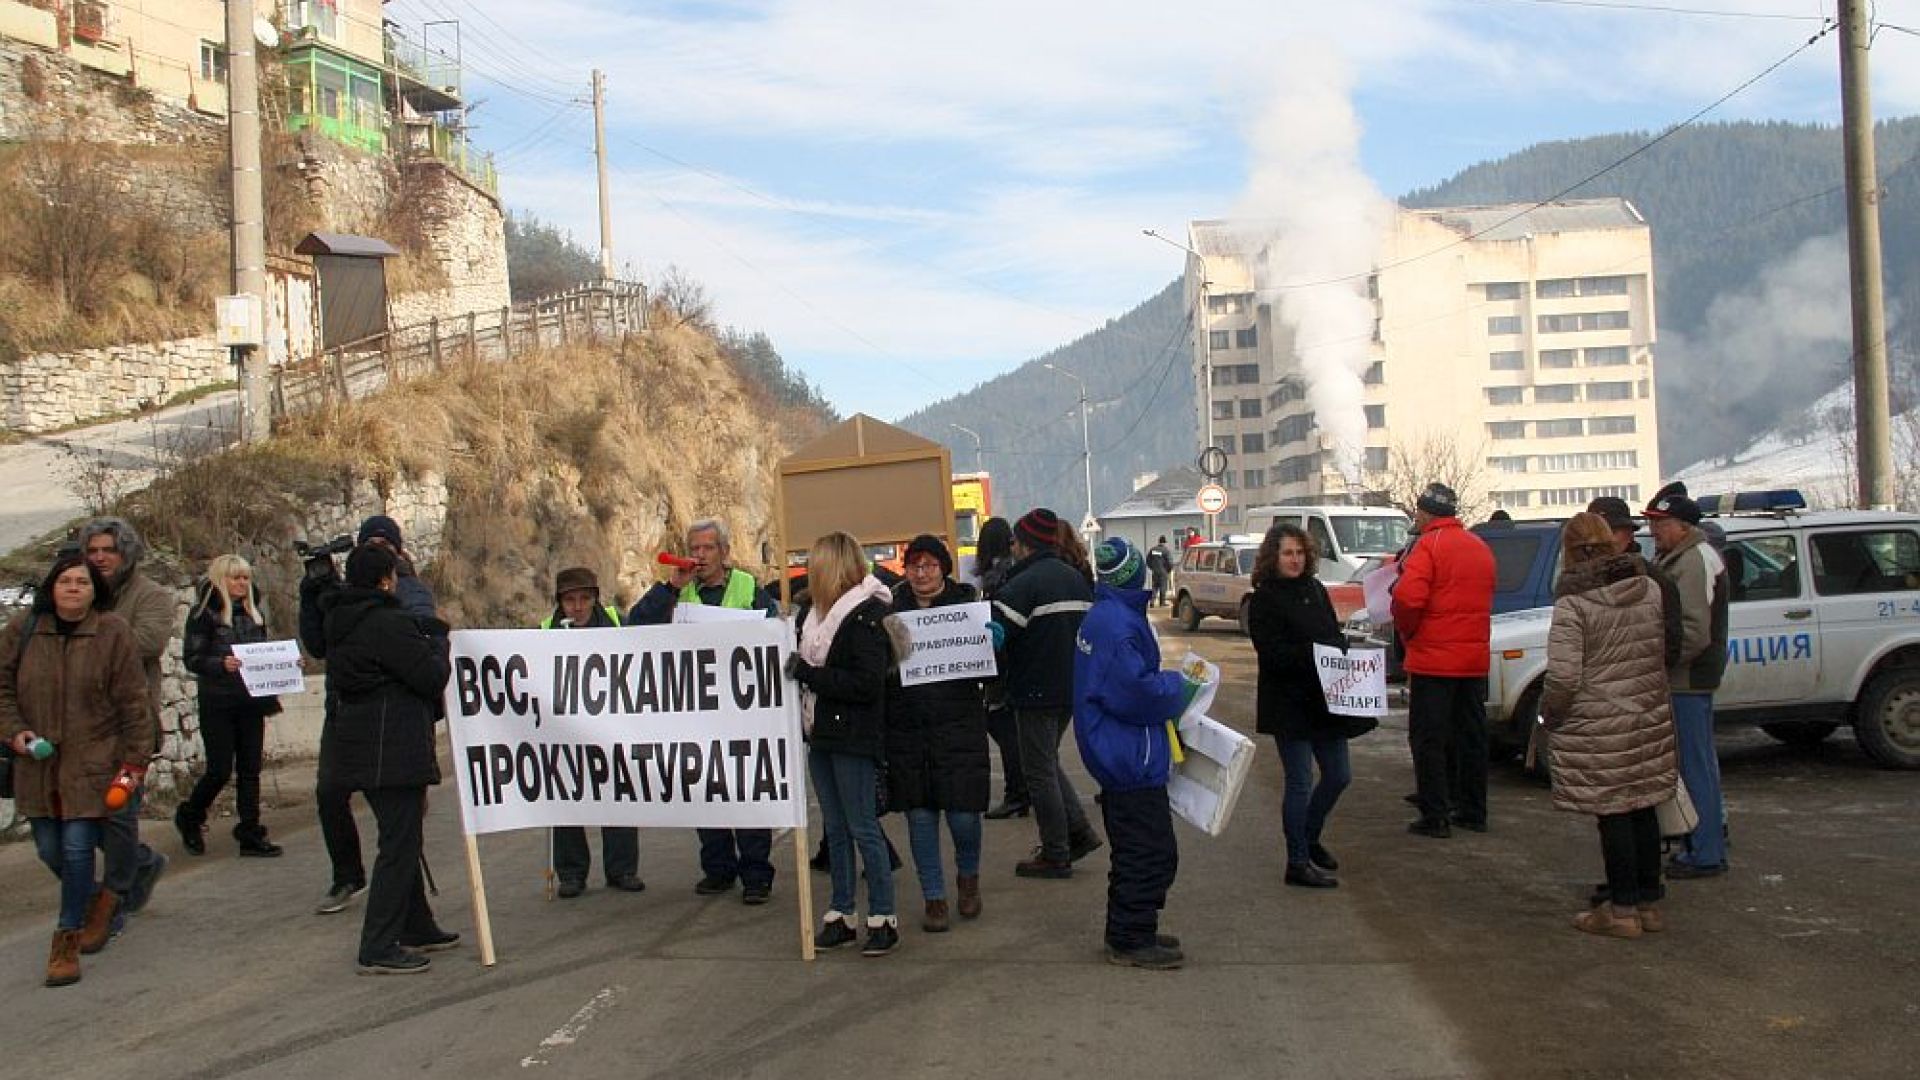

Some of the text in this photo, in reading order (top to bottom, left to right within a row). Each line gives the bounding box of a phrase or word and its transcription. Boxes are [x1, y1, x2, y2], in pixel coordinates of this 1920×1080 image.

[917, 612, 968, 627] ГОСПОДА
[455, 645, 783, 729] ВСС, ИСКАМЕ СИ
[906, 667, 922, 677] НЕ
[925, 663, 945, 675] СТЕ
[466, 738, 789, 807] ПРОКУРАТУРАТА!
